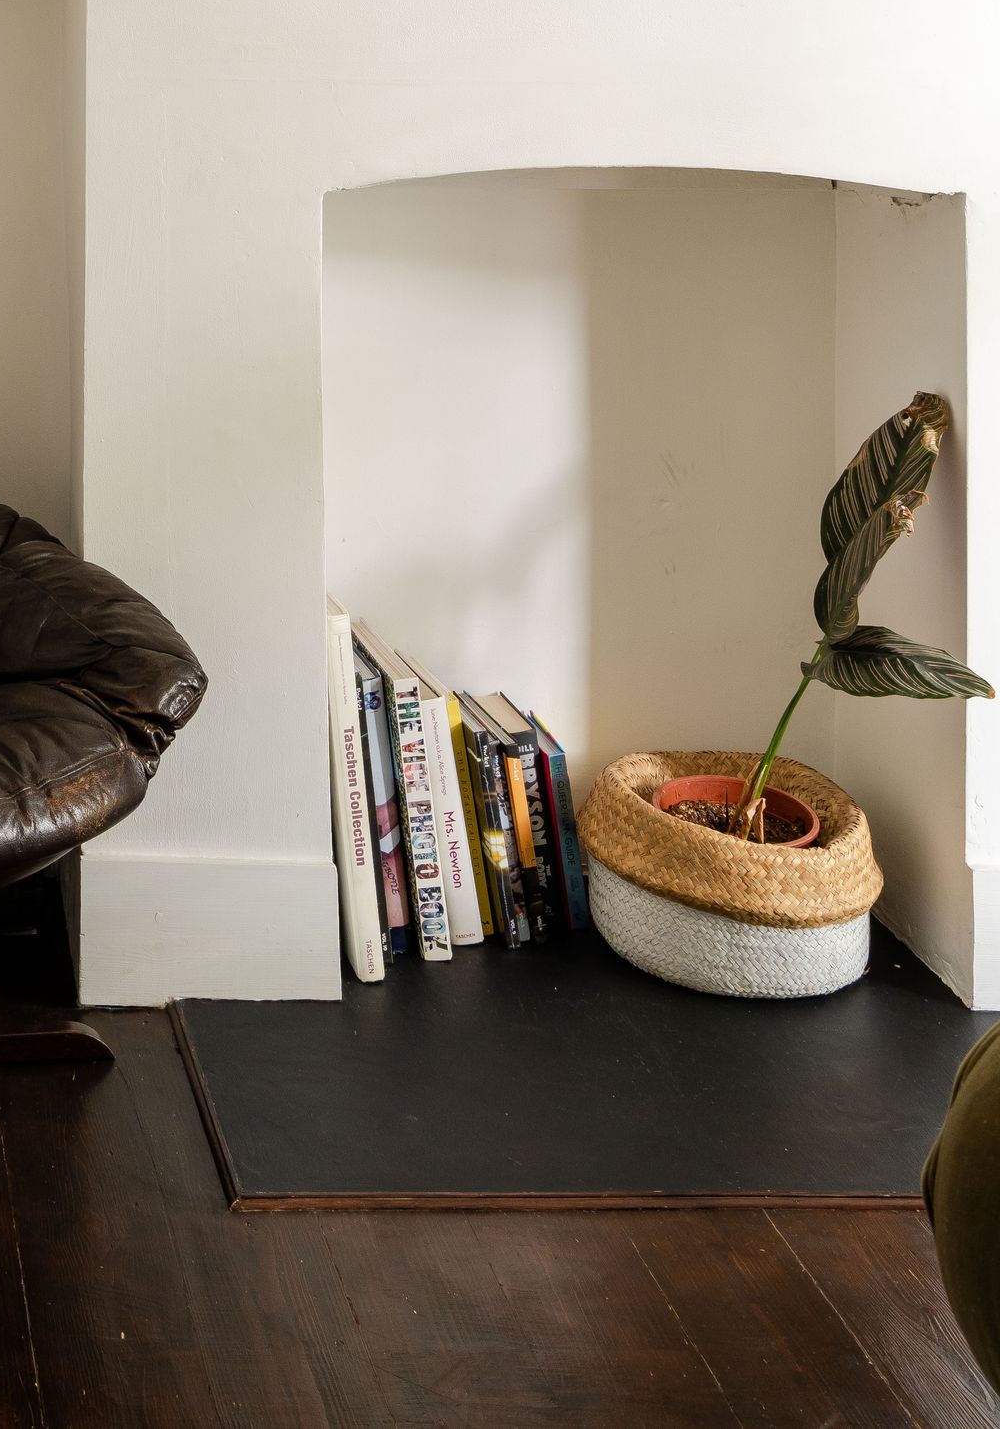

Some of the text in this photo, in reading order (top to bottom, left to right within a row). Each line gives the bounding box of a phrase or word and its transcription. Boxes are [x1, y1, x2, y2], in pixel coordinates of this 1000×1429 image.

[430, 708, 438, 721] June
[431, 721, 441, 744] Newton
[342, 725, 359, 788] Taschen
[437, 761, 446, 774] Alice
[482, 744, 490, 768] Pocket
[492, 754, 501, 778] Pocket
[554, 761, 564, 779] THE
[438, 775, 449, 796] Springs
[520, 753, 547, 847] BRYSON
[556, 780, 568, 810] QUEER
[347, 790, 367, 868] Collection
[396, 685, 449, 954] THE VICE PHOTO BOOK
[456, 750, 482, 880] THE BOTANICAL CITY
[443, 811, 464, 889] Mrs. Newton
[564, 836, 577, 867] GUIDE
[365, 939, 376, 975] TASCHEN
